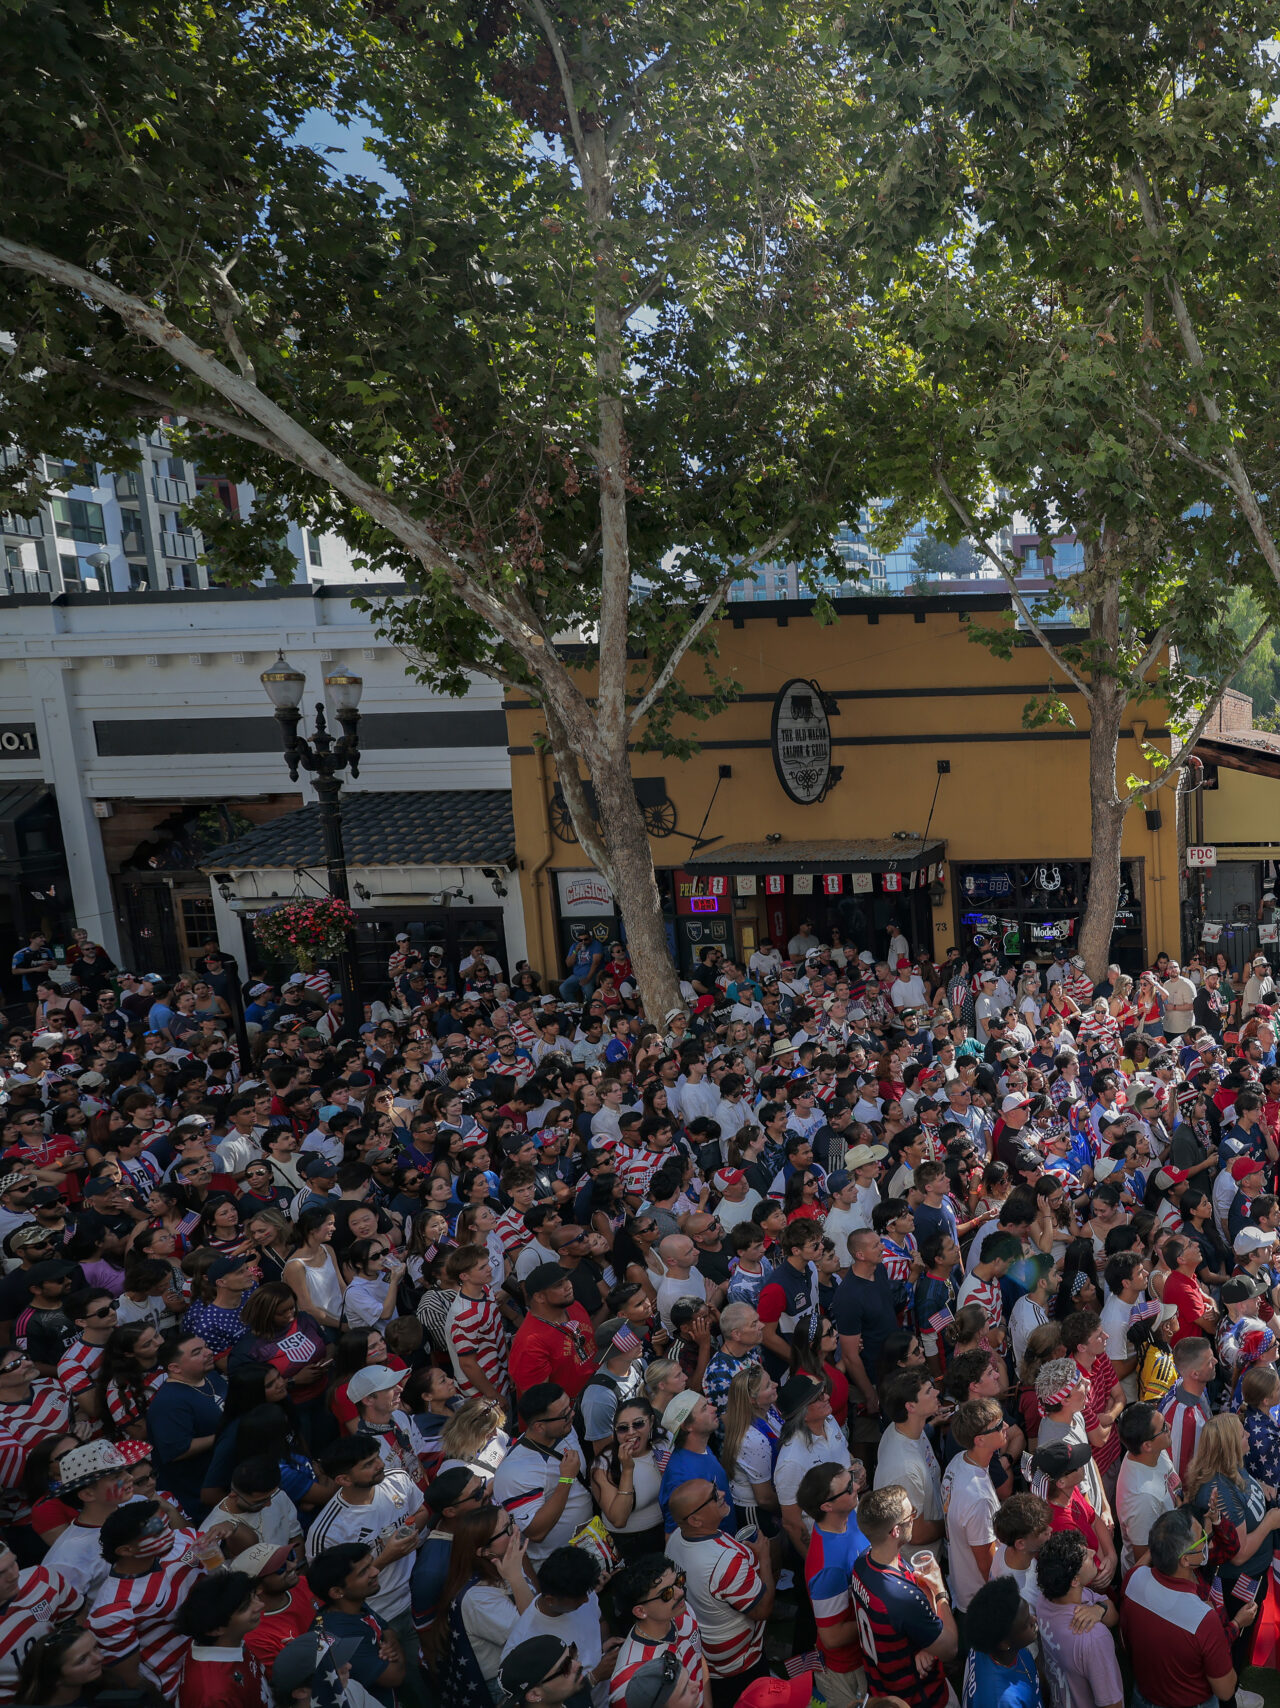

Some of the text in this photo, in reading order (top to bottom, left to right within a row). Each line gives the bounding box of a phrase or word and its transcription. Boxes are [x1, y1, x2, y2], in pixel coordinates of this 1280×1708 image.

[781, 728, 827, 742] THE OLD WAGON
[783, 743, 827, 758] SALOON & GRILL
[1190, 848, 1213, 860] FDC
[888, 861, 897, 870] 73
[935, 922, 948, 932] 73
[1033, 926, 1061, 938] Modelo
[280, 1333, 305, 1350] USA
[32, 1601, 47, 1613] USA
